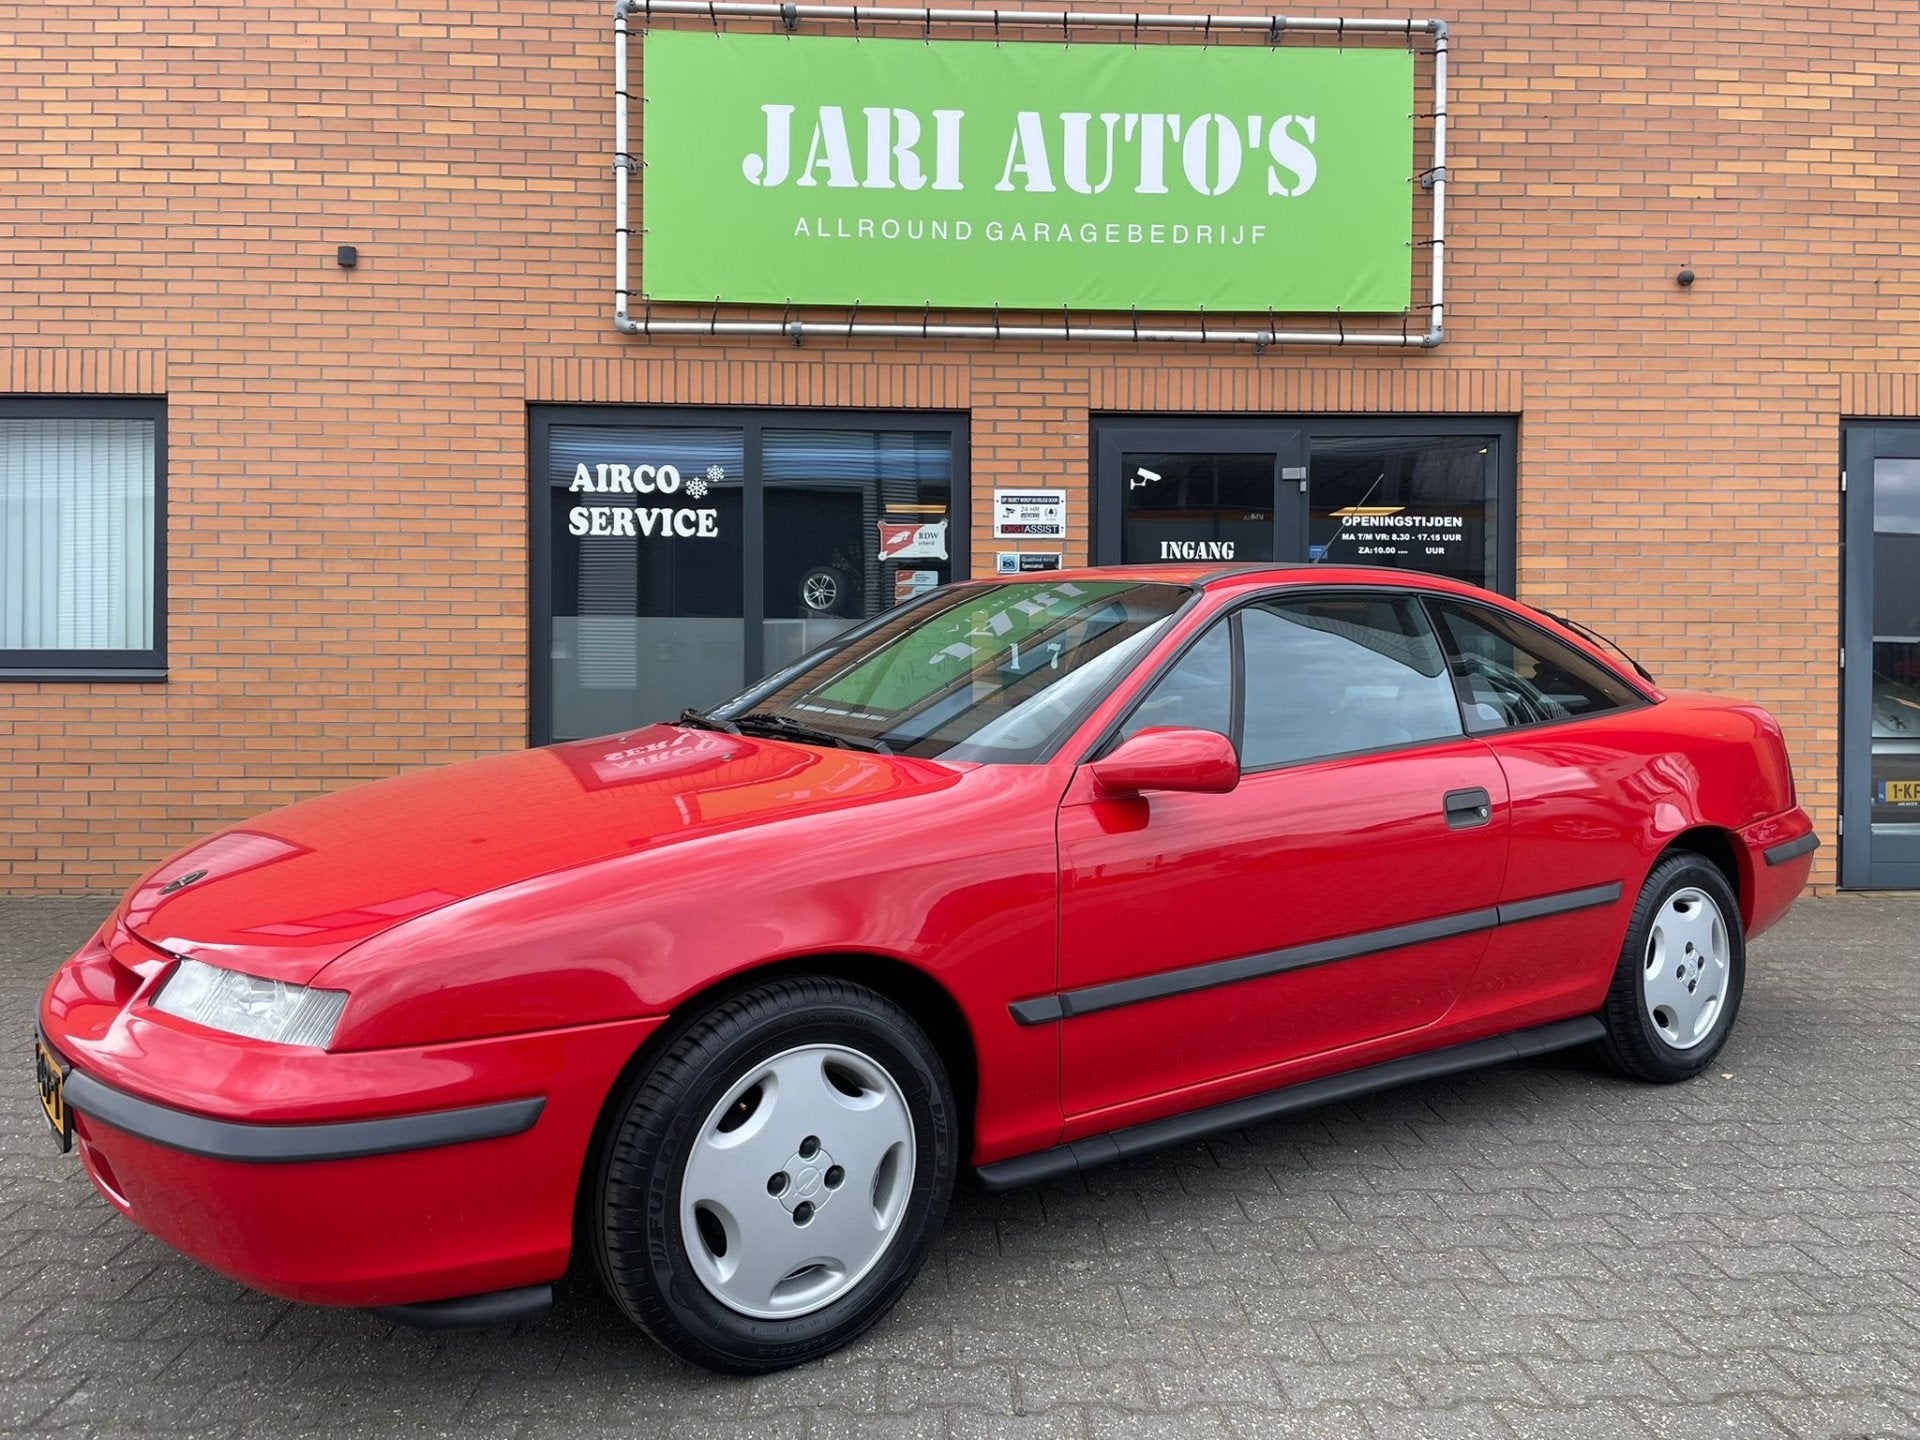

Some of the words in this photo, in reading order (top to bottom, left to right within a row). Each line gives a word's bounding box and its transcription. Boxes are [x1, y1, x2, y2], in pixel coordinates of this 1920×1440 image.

[742, 103, 966, 191] JARI
[995, 110, 1318, 198] AUTO'S
[794, 217, 972, 241] ALLROUND
[986, 221, 1267, 246] GARAGEBEDRIJF
[568, 462, 681, 494] AIRCO
[568, 506, 719, 538] SERVICE
[1342, 516, 1463, 527] OPENINGSTIJDEN
[918, 532, 940, 540] RDW
[1002, 525, 1059, 534] DIGIASSIST
[1341, 533, 1356, 541] MA
[1357, 533, 1374, 541] T/M
[1374, 533, 1390, 541] VR:
[1391, 533, 1410, 541] 8.30
[1416, 533, 1441, 542] 17.15
[1442, 533, 1462, 542] UUR
[1160, 540, 1235, 560] INGANG
[1425, 546, 1446, 555] UUR
